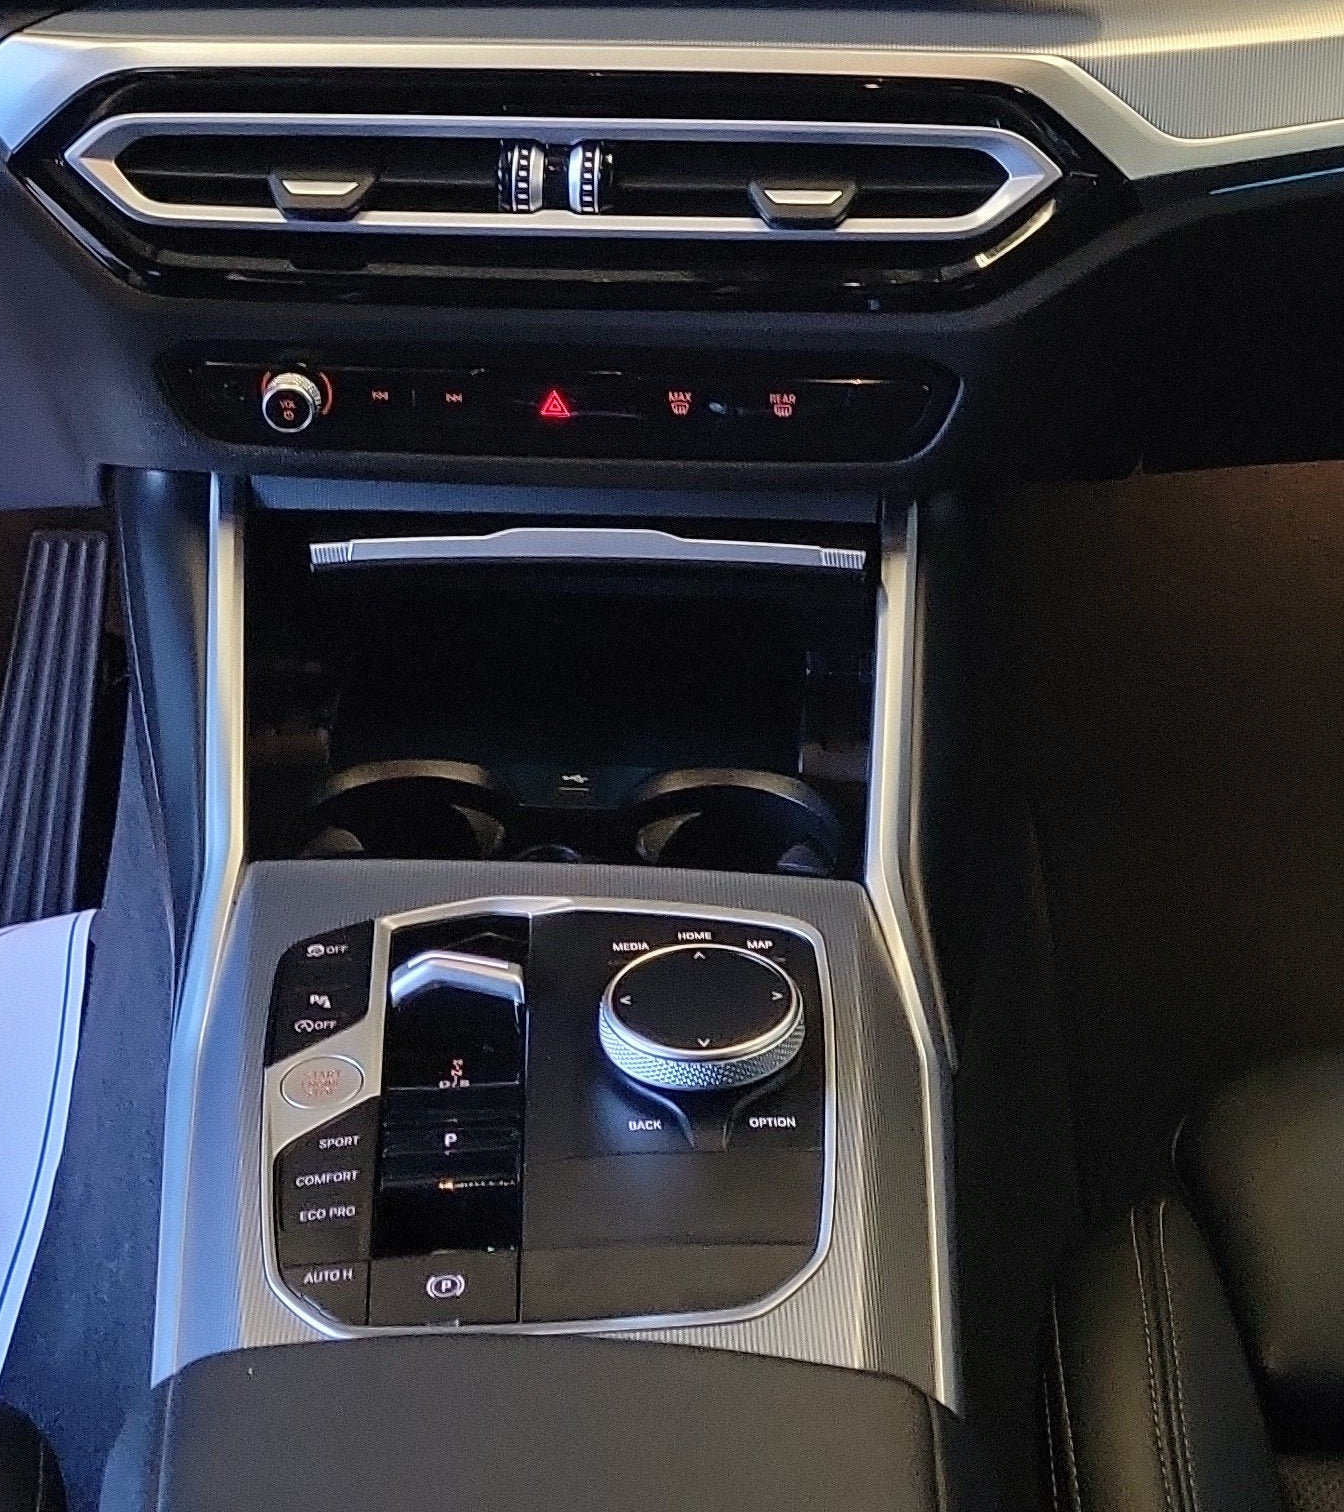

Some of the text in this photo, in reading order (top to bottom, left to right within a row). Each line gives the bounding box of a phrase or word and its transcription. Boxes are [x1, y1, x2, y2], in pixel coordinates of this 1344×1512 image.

[677, 931, 713, 941] HOME
[612, 941, 650, 952] MEDIA
[746, 939, 773, 950] MAP
[628, 1118, 663, 1131] BACK
[748, 1115, 797, 1129] OPTION
[318, 1135, 360, 1150] SPORT
[295, 1169, 359, 1188] COMFORT
[299, 1207, 327, 1223] ECO
[303, 1268, 341, 1285] AUTO
